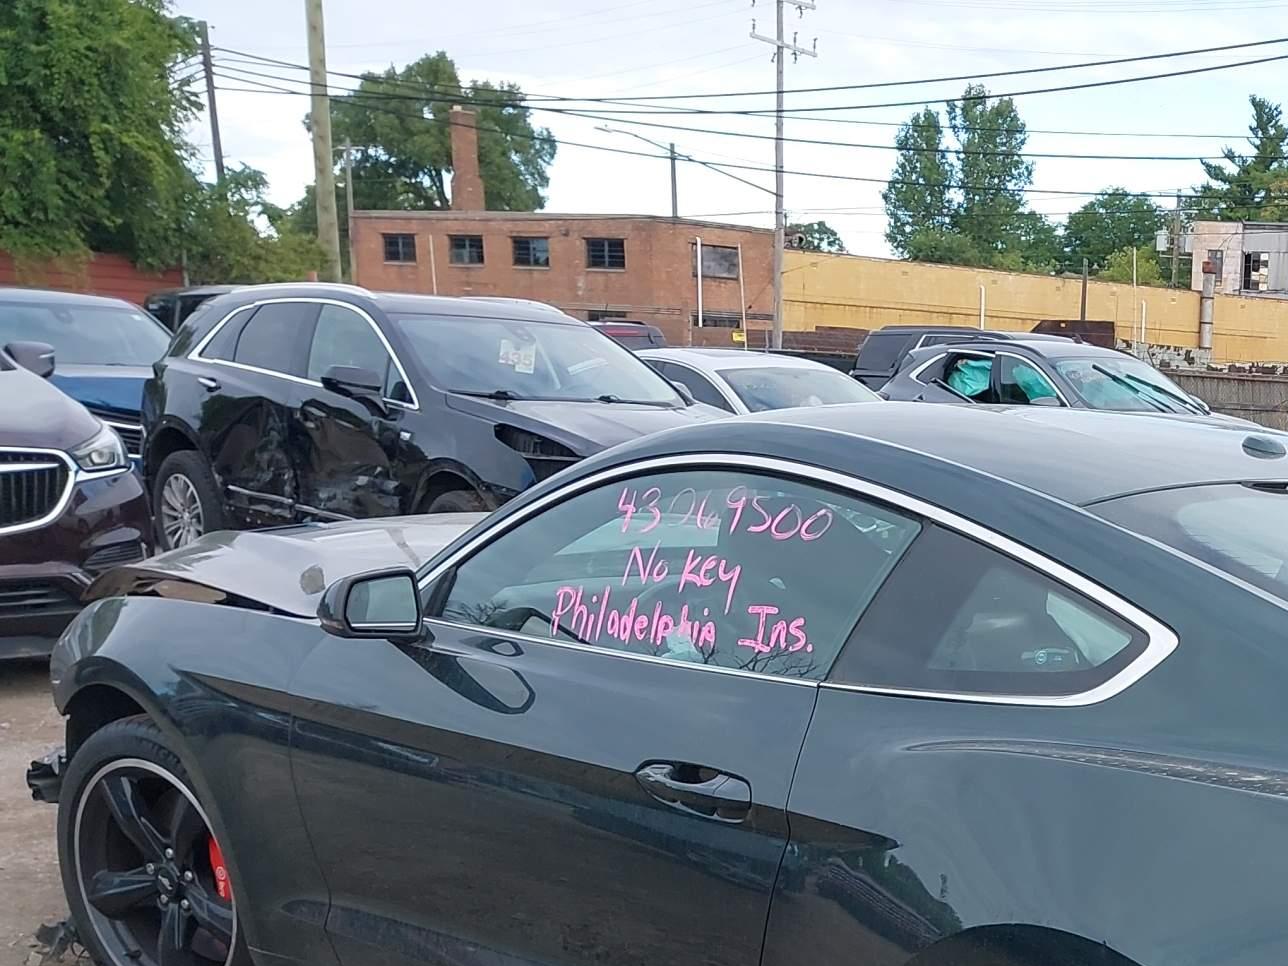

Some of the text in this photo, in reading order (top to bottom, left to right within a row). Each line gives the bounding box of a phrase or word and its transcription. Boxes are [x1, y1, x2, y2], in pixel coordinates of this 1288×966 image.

[617, 485, 833, 541] 43069500
[622, 540, 669, 586] No
[551, 585, 815, 653] Philadelphia Ins.
